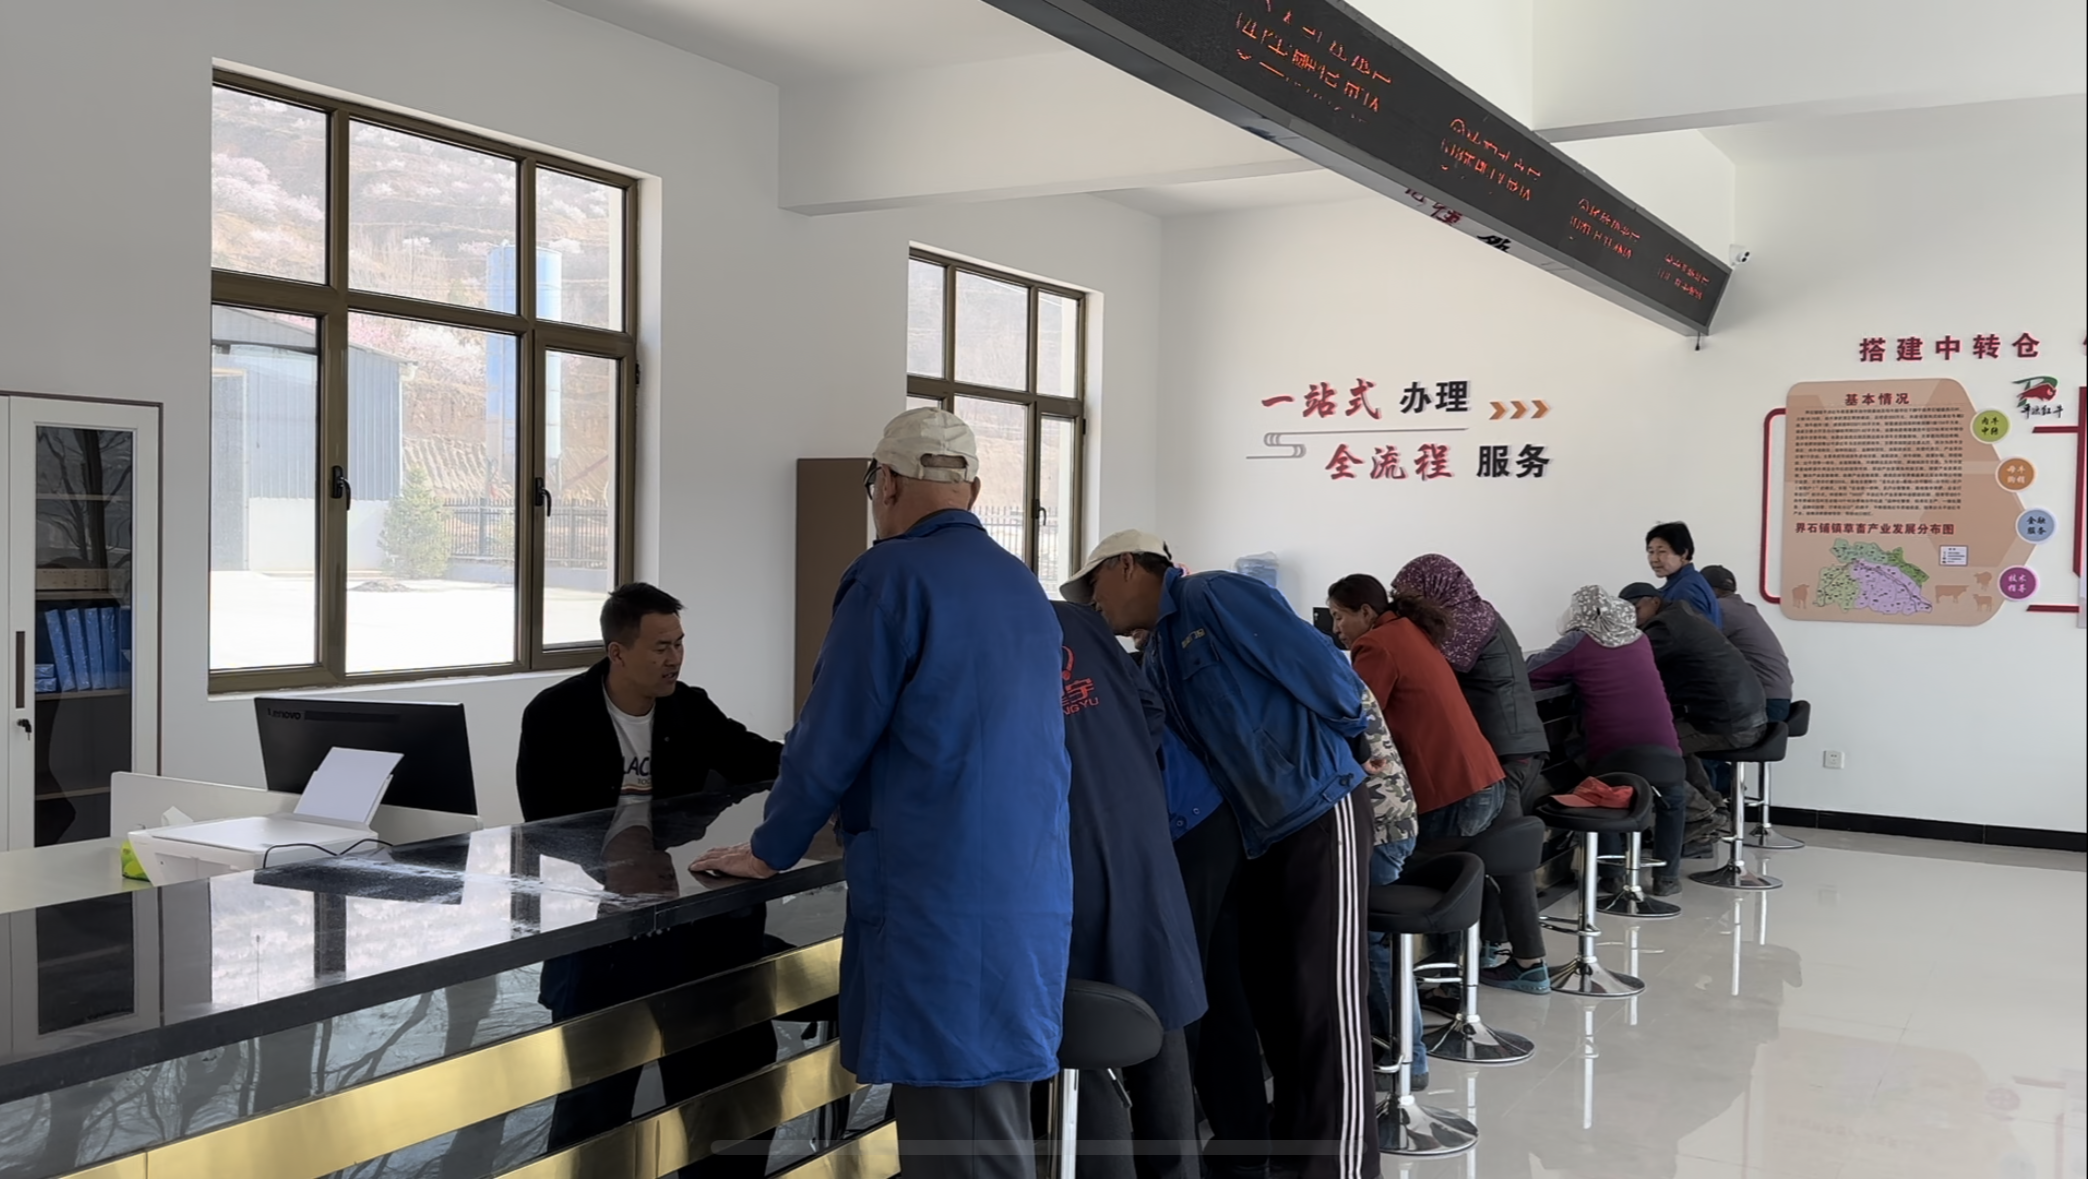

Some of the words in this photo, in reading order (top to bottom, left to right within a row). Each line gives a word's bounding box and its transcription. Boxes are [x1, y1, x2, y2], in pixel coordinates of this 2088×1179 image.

[1859, 332, 2040, 362] 搭建中转仓
[1261, 378, 1381, 420] 一站式
[1399, 380, 1469, 414] 办理
[1845, 393, 1910, 406] 基本情况
[1325, 443, 1454, 481] 全流程
[1476, 444, 1550, 478] 服务
[2026, 516, 2046, 525] 金融
[1795, 522, 1955, 535] 界石铺镇草畜产业发展分布图
[2027, 526, 2046, 535] 服务
[1061, 678, 1095, 706] 宇
[267, 707, 301, 720] Lenovo
